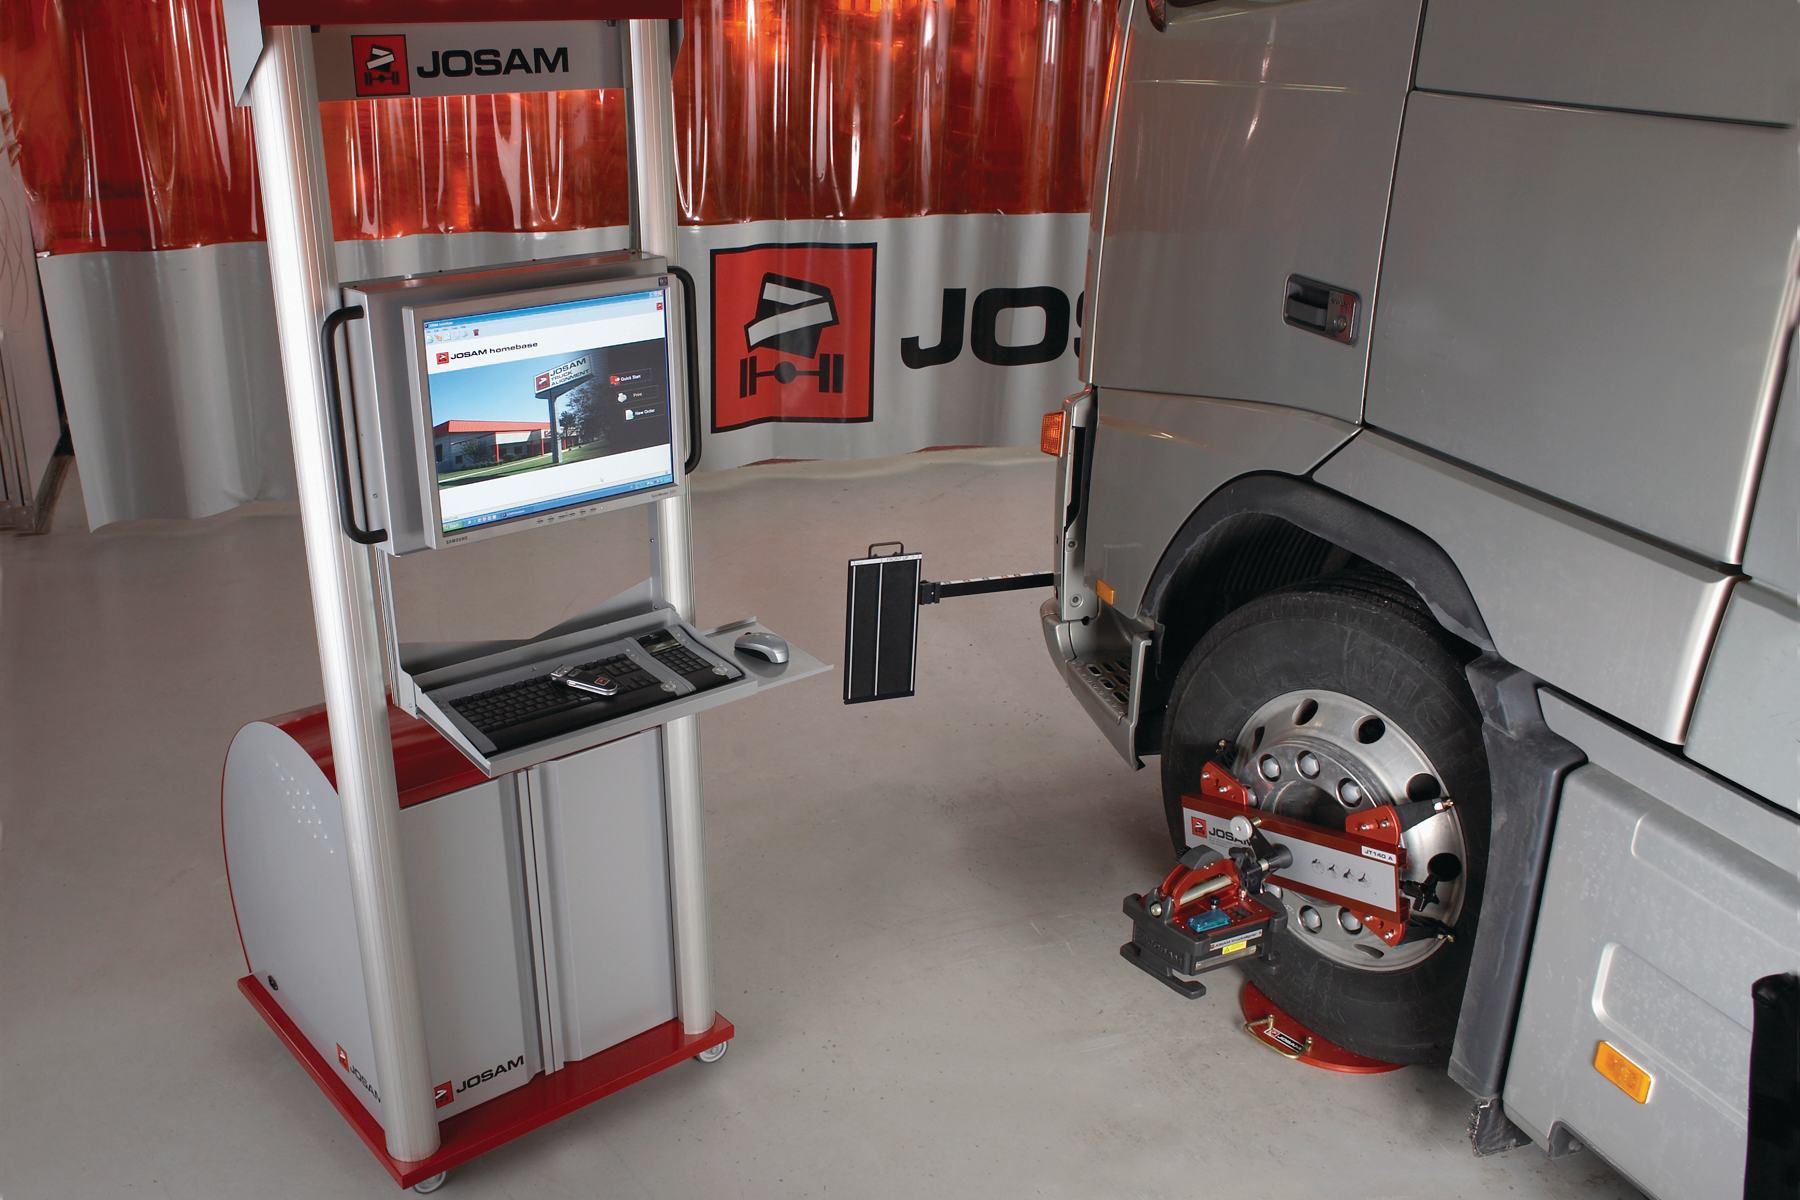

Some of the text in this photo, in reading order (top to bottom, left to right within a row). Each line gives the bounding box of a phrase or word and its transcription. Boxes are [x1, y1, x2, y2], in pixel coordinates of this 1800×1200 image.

[416, 46, 570, 79] JOSAM
[900, 285, 1085, 370] JO
[450, 342, 539, 360] JOSAM homebase
[550, 357, 587, 377] JOSAM
[550, 369, 574, 382] TRUCK
[551, 368, 590, 387] ALIGNMENT
[446, 536, 469, 545] SAMSUNG
[456, 1055, 525, 1094] JOSAM
